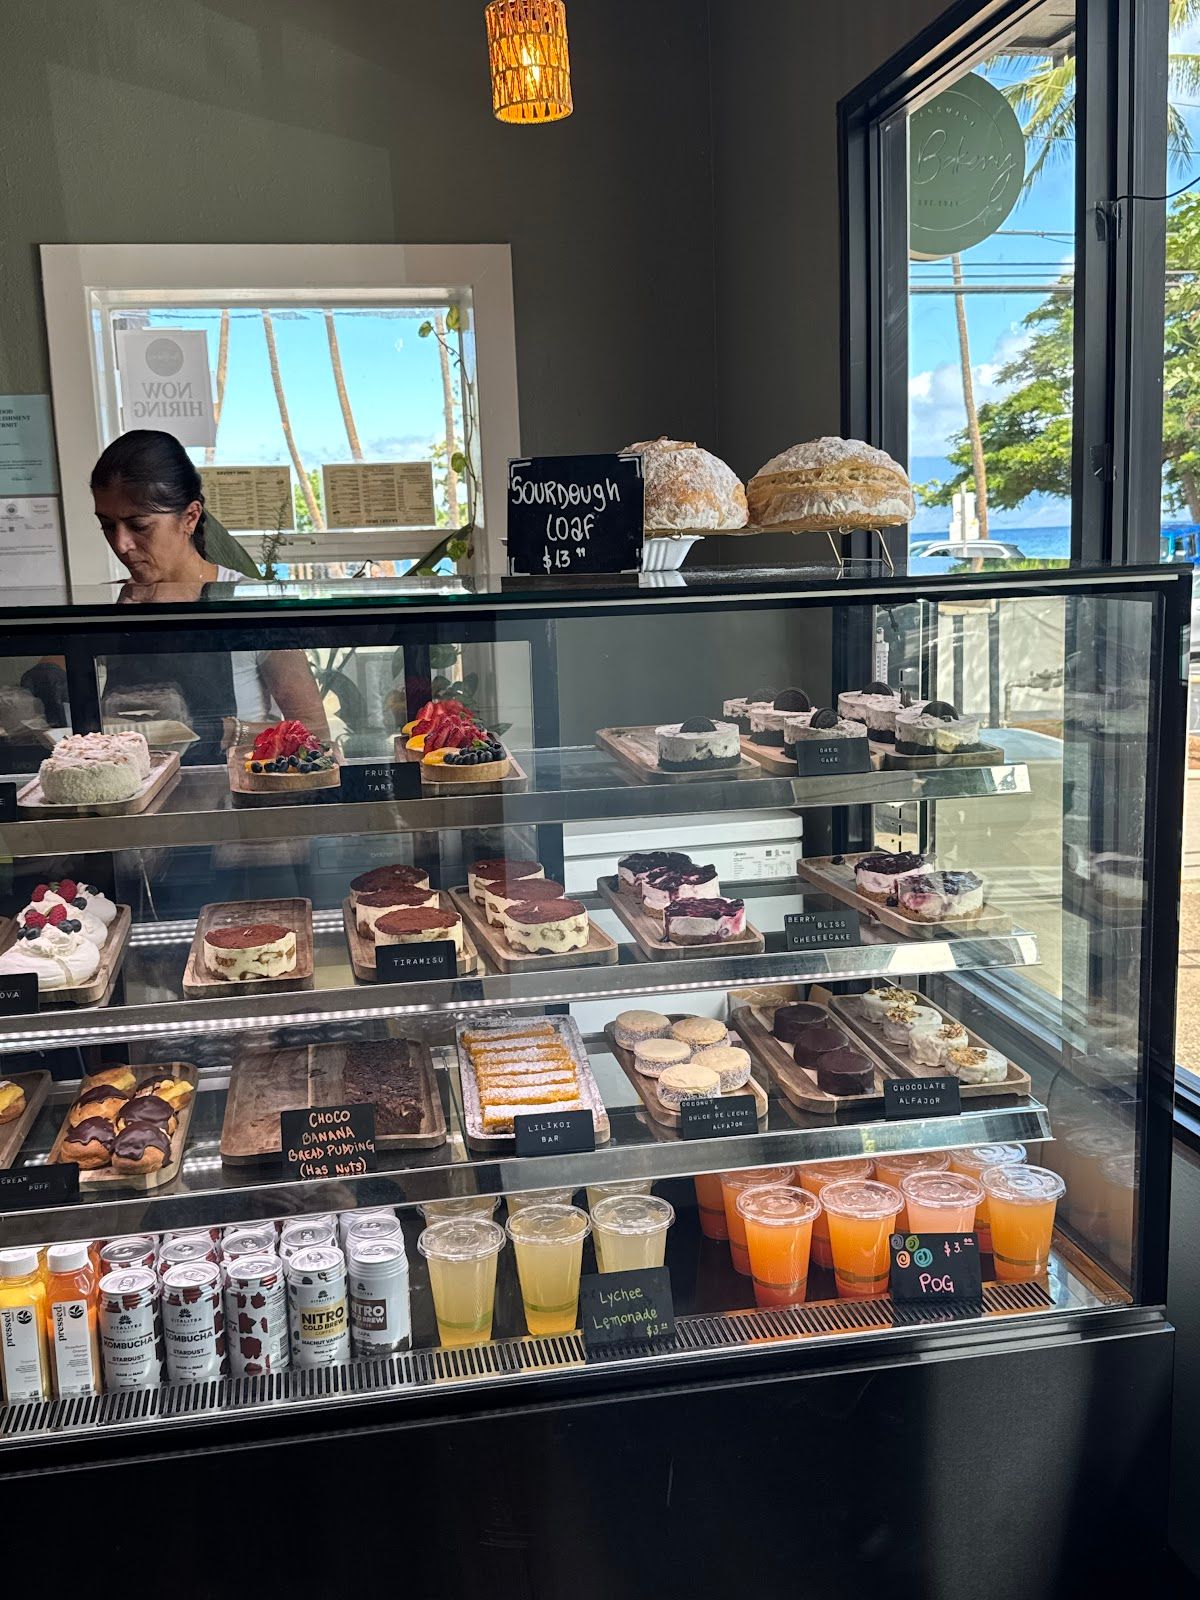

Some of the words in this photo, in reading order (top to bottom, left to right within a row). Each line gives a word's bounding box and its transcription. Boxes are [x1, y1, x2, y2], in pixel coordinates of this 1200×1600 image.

[912, 129, 1016, 202] Bakery
[365, 769, 396, 777] FRUIT
[367, 783, 392, 791] TART
[787, 915, 816, 923] BERRY
[817, 920, 846, 929] BLISS
[393, 956, 444, 967] TIRAMISU
[892, 1082, 947, 1092] CHOCOLATE
[899, 1097, 941, 1105] ALFAJOR
[308, 1110, 351, 1128] CHOCO
[528, 1121, 571, 1133] LILIKOI
[712, 1121, 743, 1130] ALFAJOR
[302, 1125, 356, 1145] BANANA
[541, 1134, 559, 1143] BAR
[288, 1147, 325, 1162] BREAD
[301, 1306, 344, 1325] NITRO
[362, 1316, 385, 1324] BREW
[592, 1307, 658, 1330] Lemonade
[302, 1323, 324, 1331] COLD
[324, 1316, 344, 1330] BREW
[165, 1331, 214, 1343] KOMBUCHA
[103, 1336, 154, 1350] KOMBUCHA
[173, 1348, 205, 1356] STARDUST
[112, 1354, 145, 1362] STARDUST
